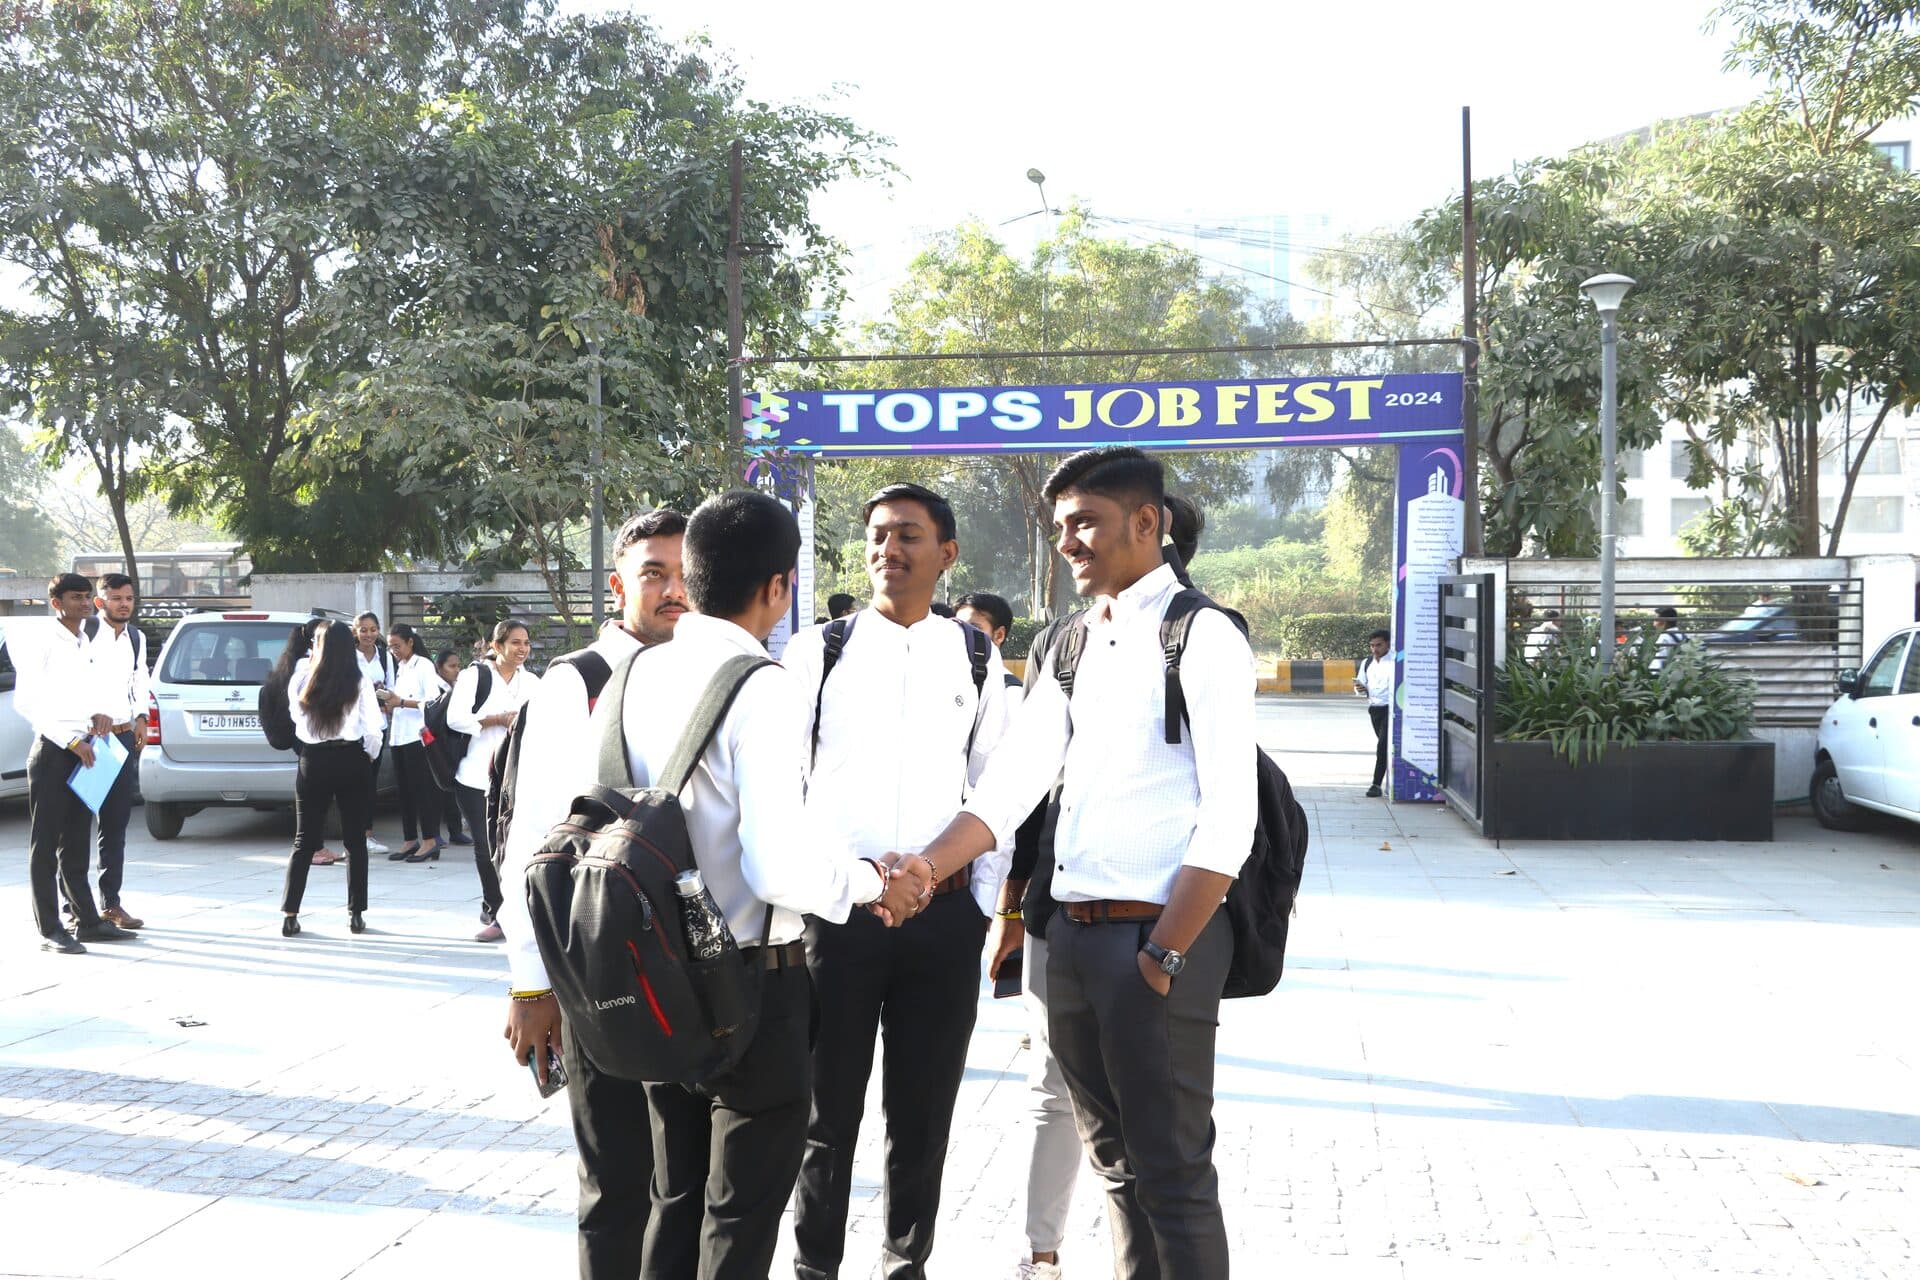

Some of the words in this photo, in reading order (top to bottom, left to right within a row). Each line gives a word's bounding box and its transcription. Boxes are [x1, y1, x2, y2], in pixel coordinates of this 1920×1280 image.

[822, 390, 1043, 433] TOPS
[1058, 387, 1202, 430] JOB
[1216, 379, 1384, 426] FEST
[1384, 391, 1443, 407] 2024
[595, 995, 636, 1010] Lenovo
